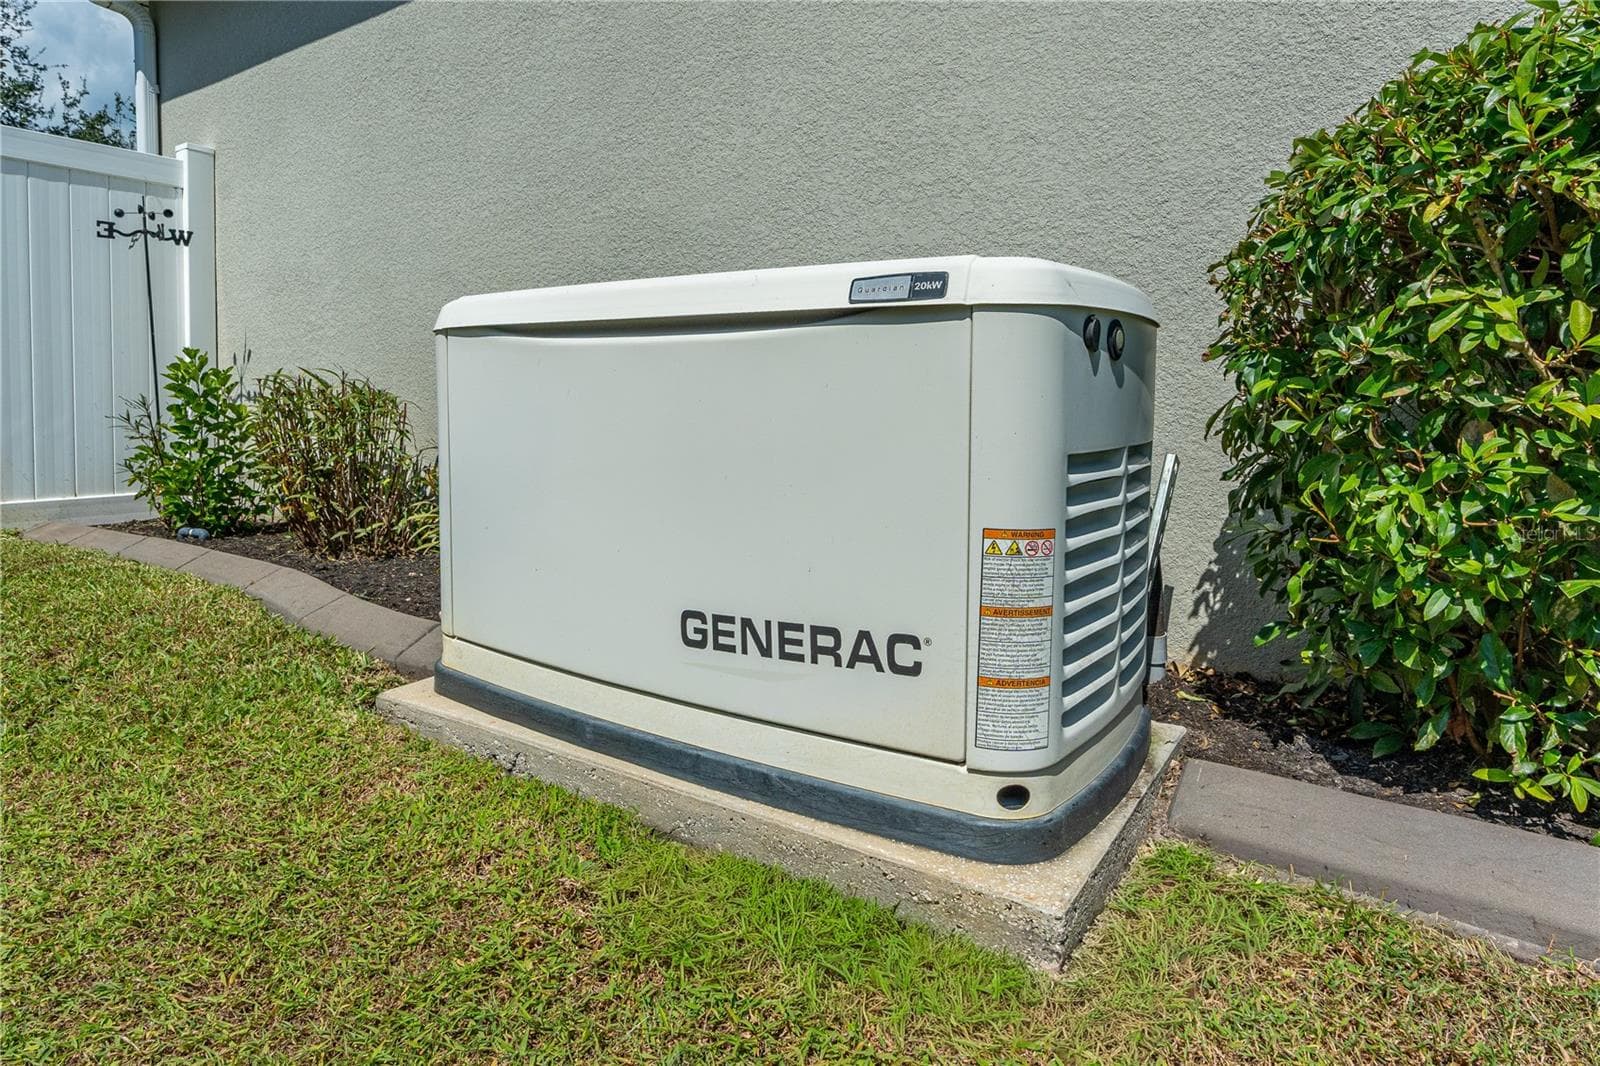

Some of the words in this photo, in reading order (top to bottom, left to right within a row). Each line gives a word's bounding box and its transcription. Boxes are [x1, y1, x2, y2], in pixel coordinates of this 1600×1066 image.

[857, 284, 905, 294] Guardian
[914, 280, 943, 291] 20kW
[992, 607, 1051, 617] AVERTISSEMENT
[995, 679, 1047, 687] ADVERTENCIA
